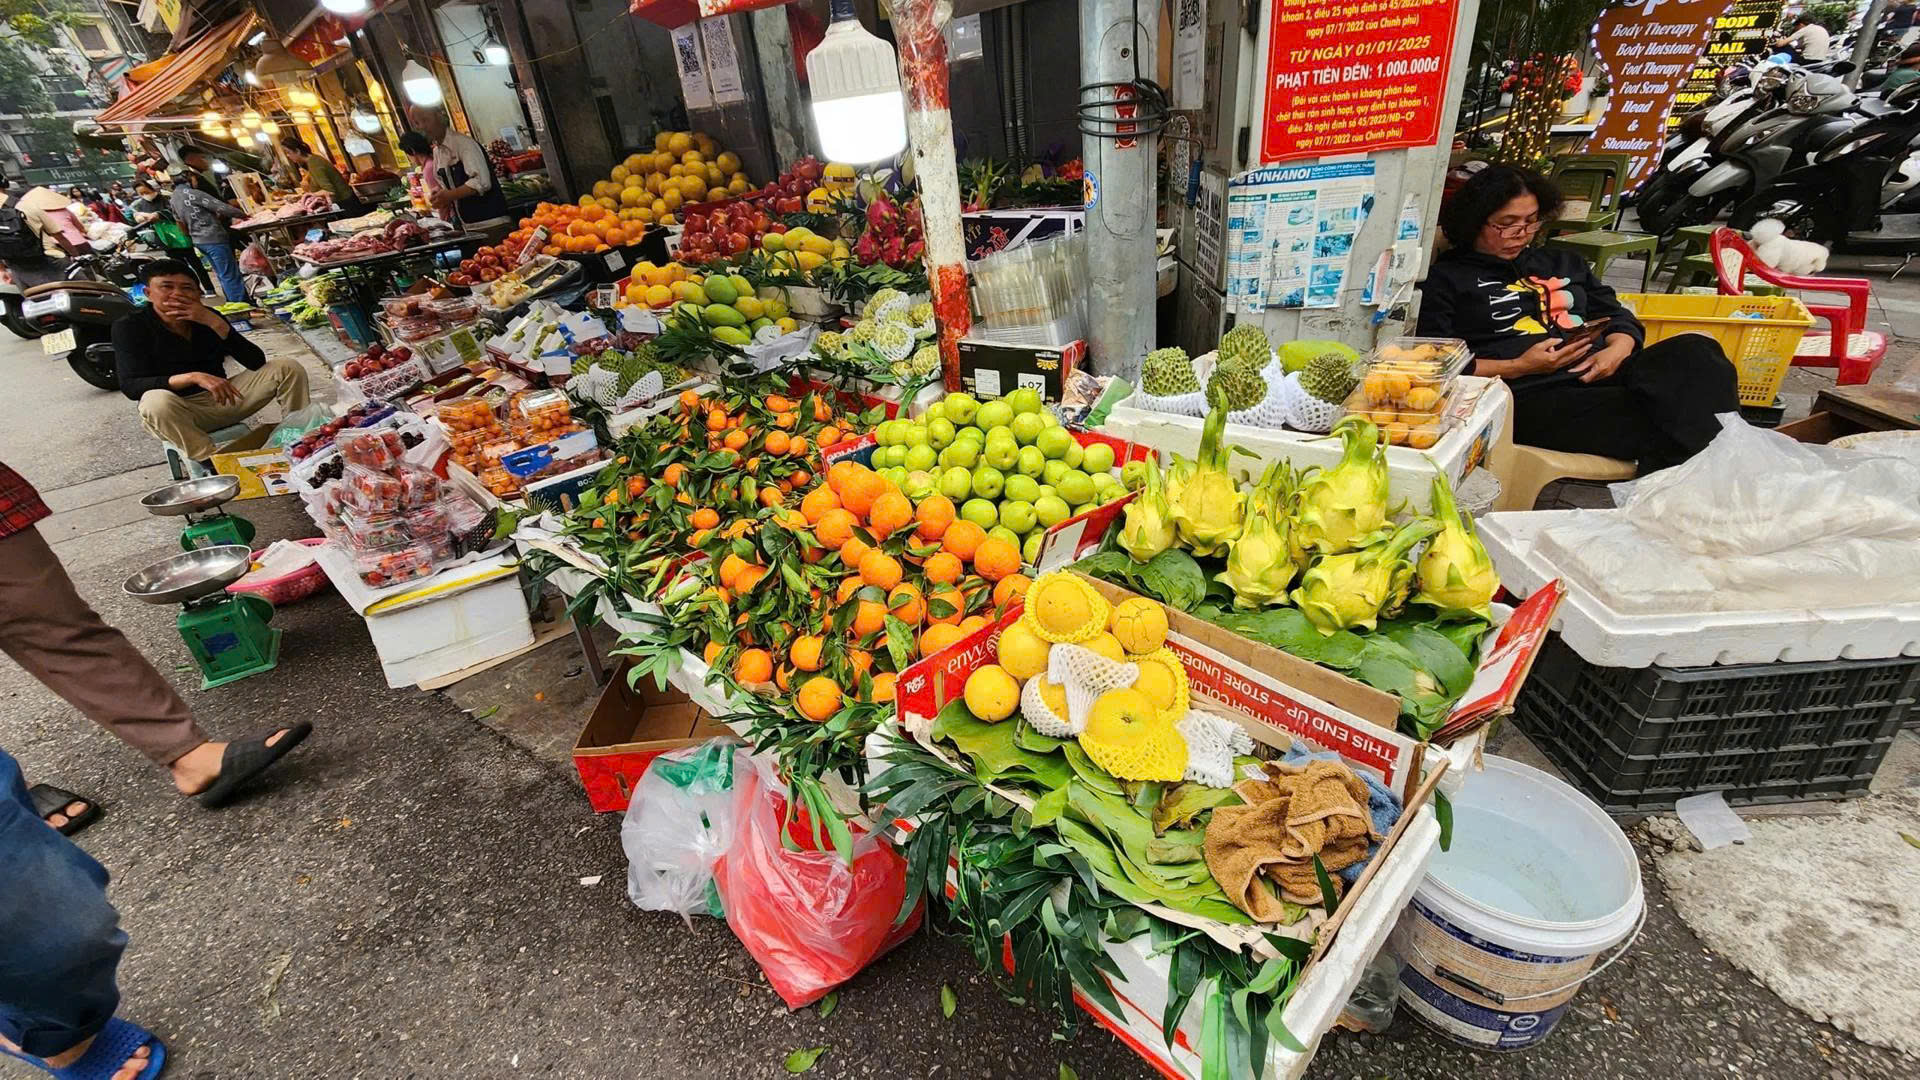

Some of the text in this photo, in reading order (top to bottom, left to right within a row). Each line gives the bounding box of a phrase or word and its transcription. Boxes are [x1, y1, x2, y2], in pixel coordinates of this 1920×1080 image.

[1331, 5, 1341, 17] 25
[1325, 20, 1364, 35] 07/7/2022
[1714, 16, 1759, 29] BODY
[1611, 22, 1698, 39] Body Therapy
[1289, 35, 1432, 64] TỪ NGÀY 01/01/2025
[1616, 42, 1696, 57] Body Hotstone
[1708, 41, 1746, 54] NAIL
[1276, 56, 1440, 91] PHẠT TIỀN ĐẾN: 1.000.000đ
[1621, 61, 1684, 77] Foot Therapy
[1619, 80, 1670, 94] Foot Scrub
[1621, 100, 1655, 113] Head
[1304, 121, 1313, 132] 26
[1627, 119, 1639, 132] &
[1314, 133, 1350, 146] 07/7/2022
[1601, 137, 1654, 151] Shoulder
[1246, 168, 1312, 184] EVNHANOI
[947, 641, 986, 674] envy
[1175, 648, 1221, 680] UNDER
[1223, 672, 1270, 705] STORE
[1287, 706, 1309, 724] UP
[1312, 717, 1349, 743] END
[1352, 735, 1393, 763] THIS
